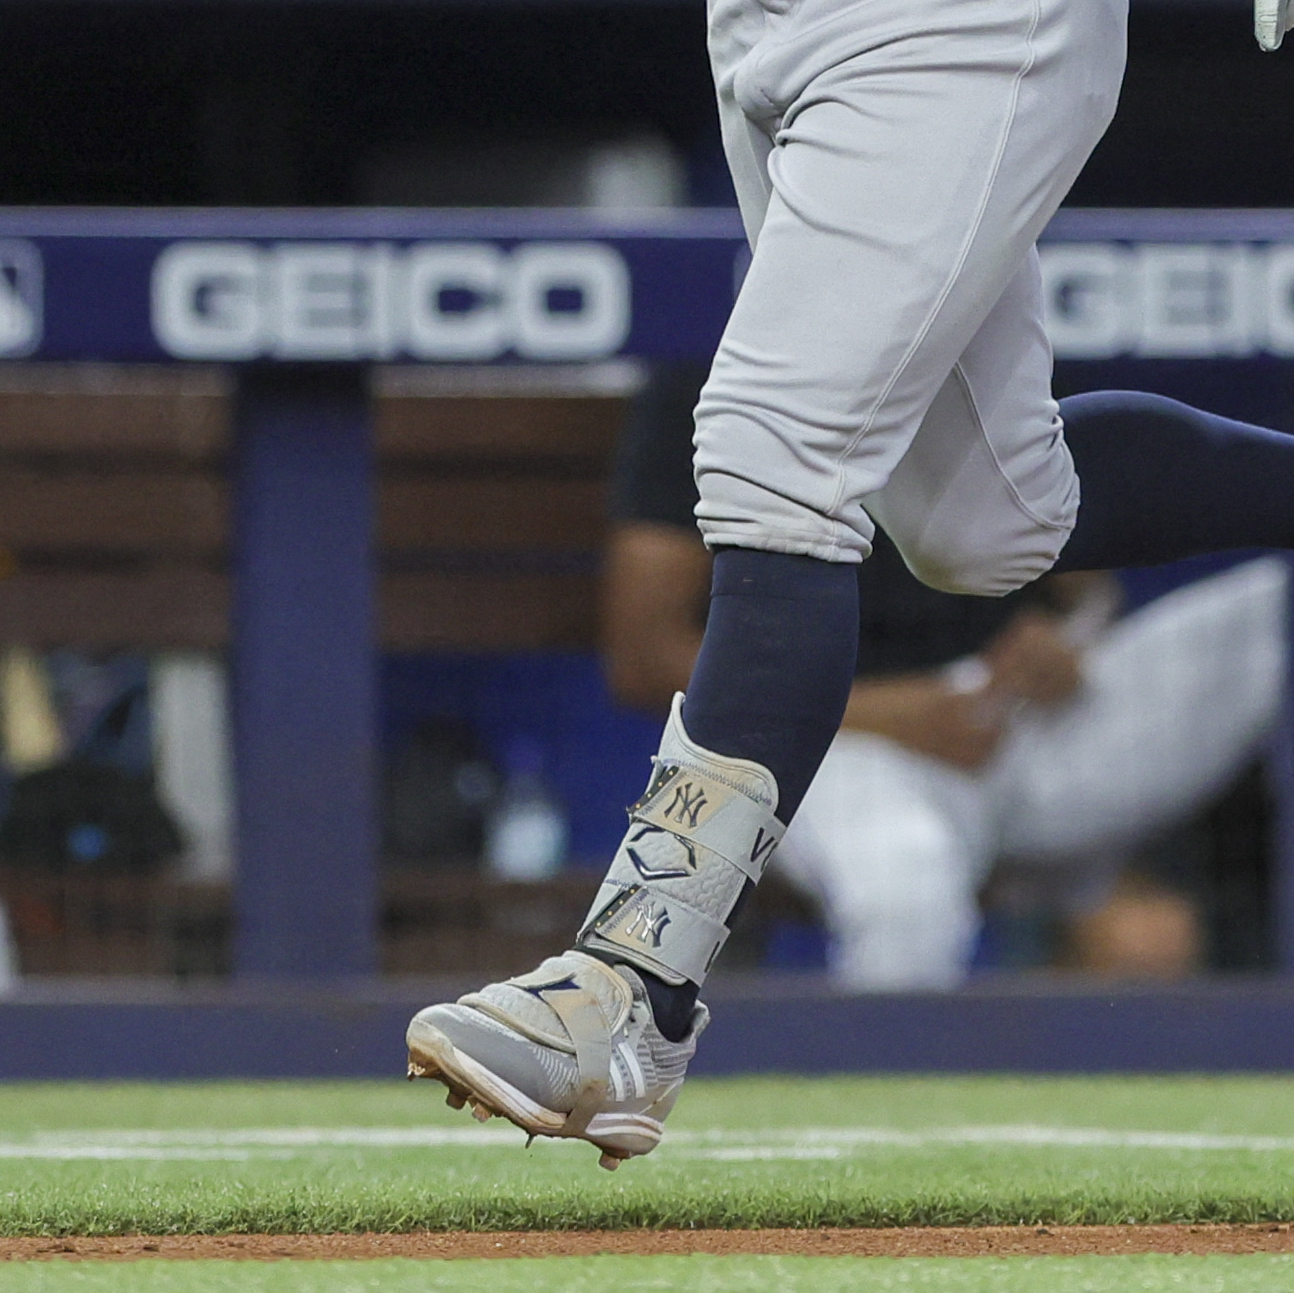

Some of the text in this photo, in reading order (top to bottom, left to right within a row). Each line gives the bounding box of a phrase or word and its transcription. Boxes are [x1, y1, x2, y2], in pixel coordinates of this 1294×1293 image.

[151, 241, 632, 362] GEICO
[664, 782, 708, 829] NY
[624, 901, 672, 948] NY
